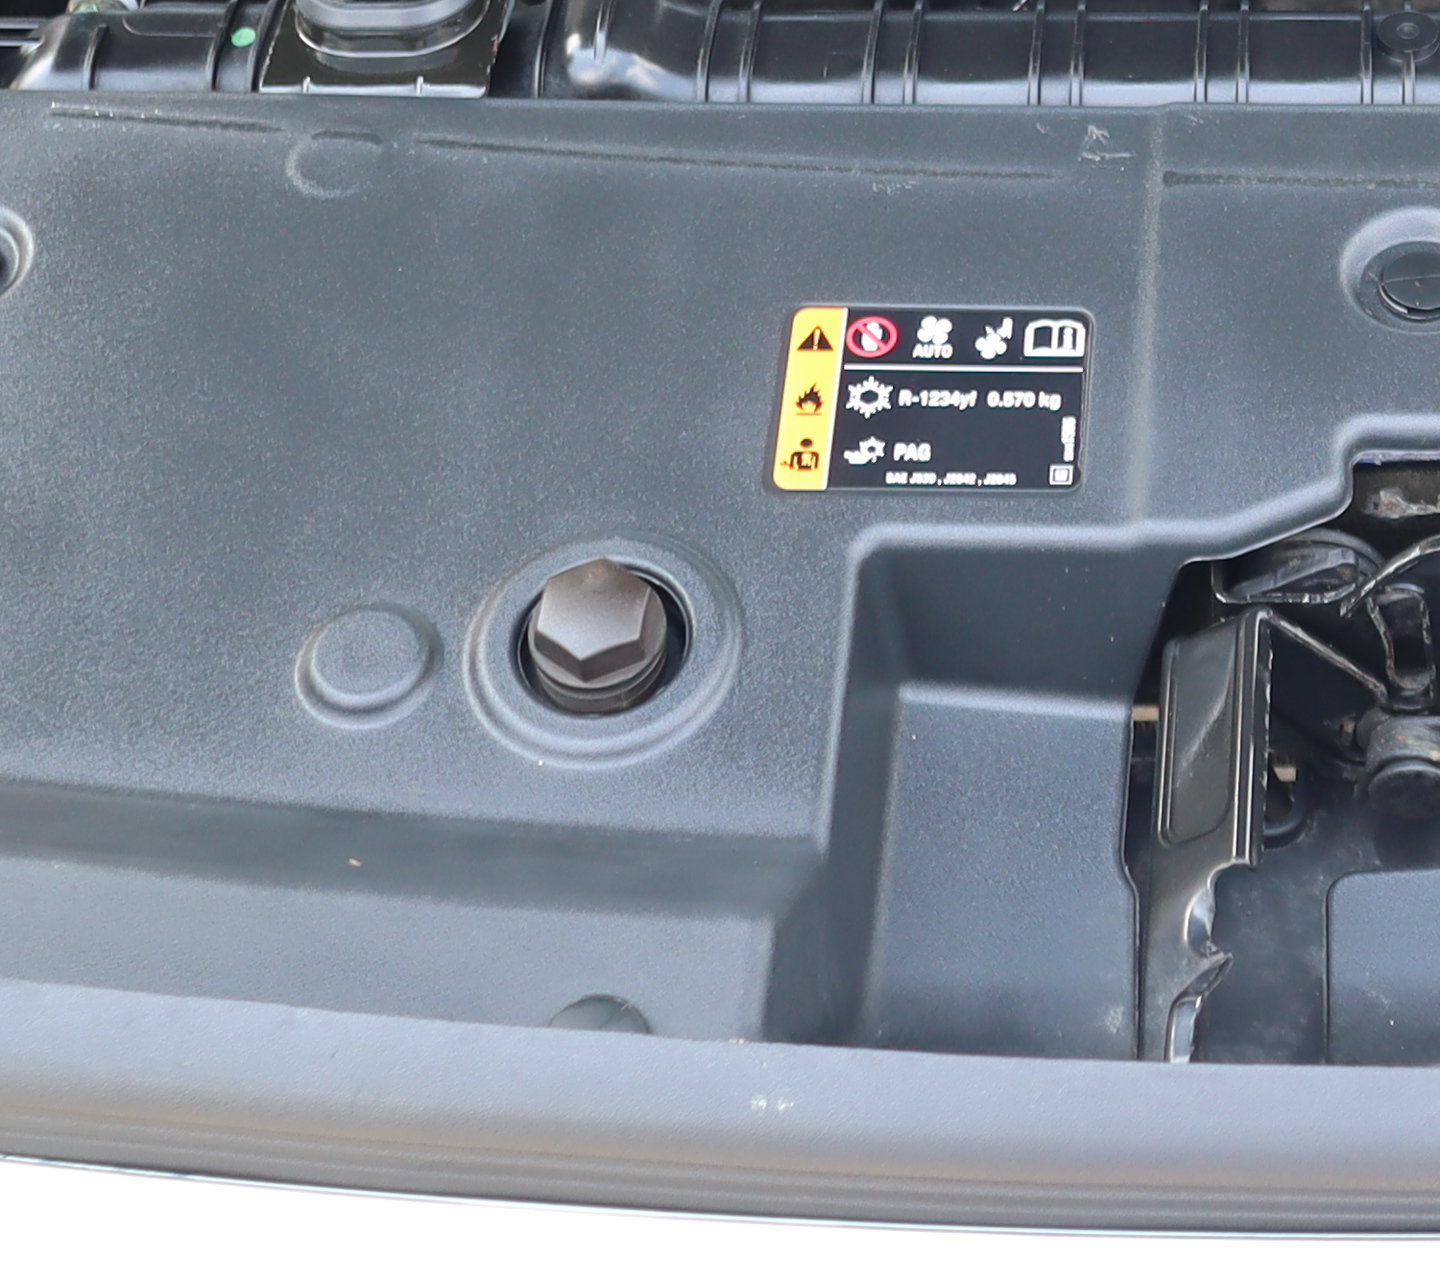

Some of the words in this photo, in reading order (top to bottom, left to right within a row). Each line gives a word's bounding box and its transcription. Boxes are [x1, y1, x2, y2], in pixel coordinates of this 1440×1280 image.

[913, 343, 954, 360] AUTO
[898, 389, 979, 411] R-1234yf
[986, 390, 1037, 409] 0.570
[1037, 390, 1063, 411] kg
[893, 442, 932, 462] PAG
